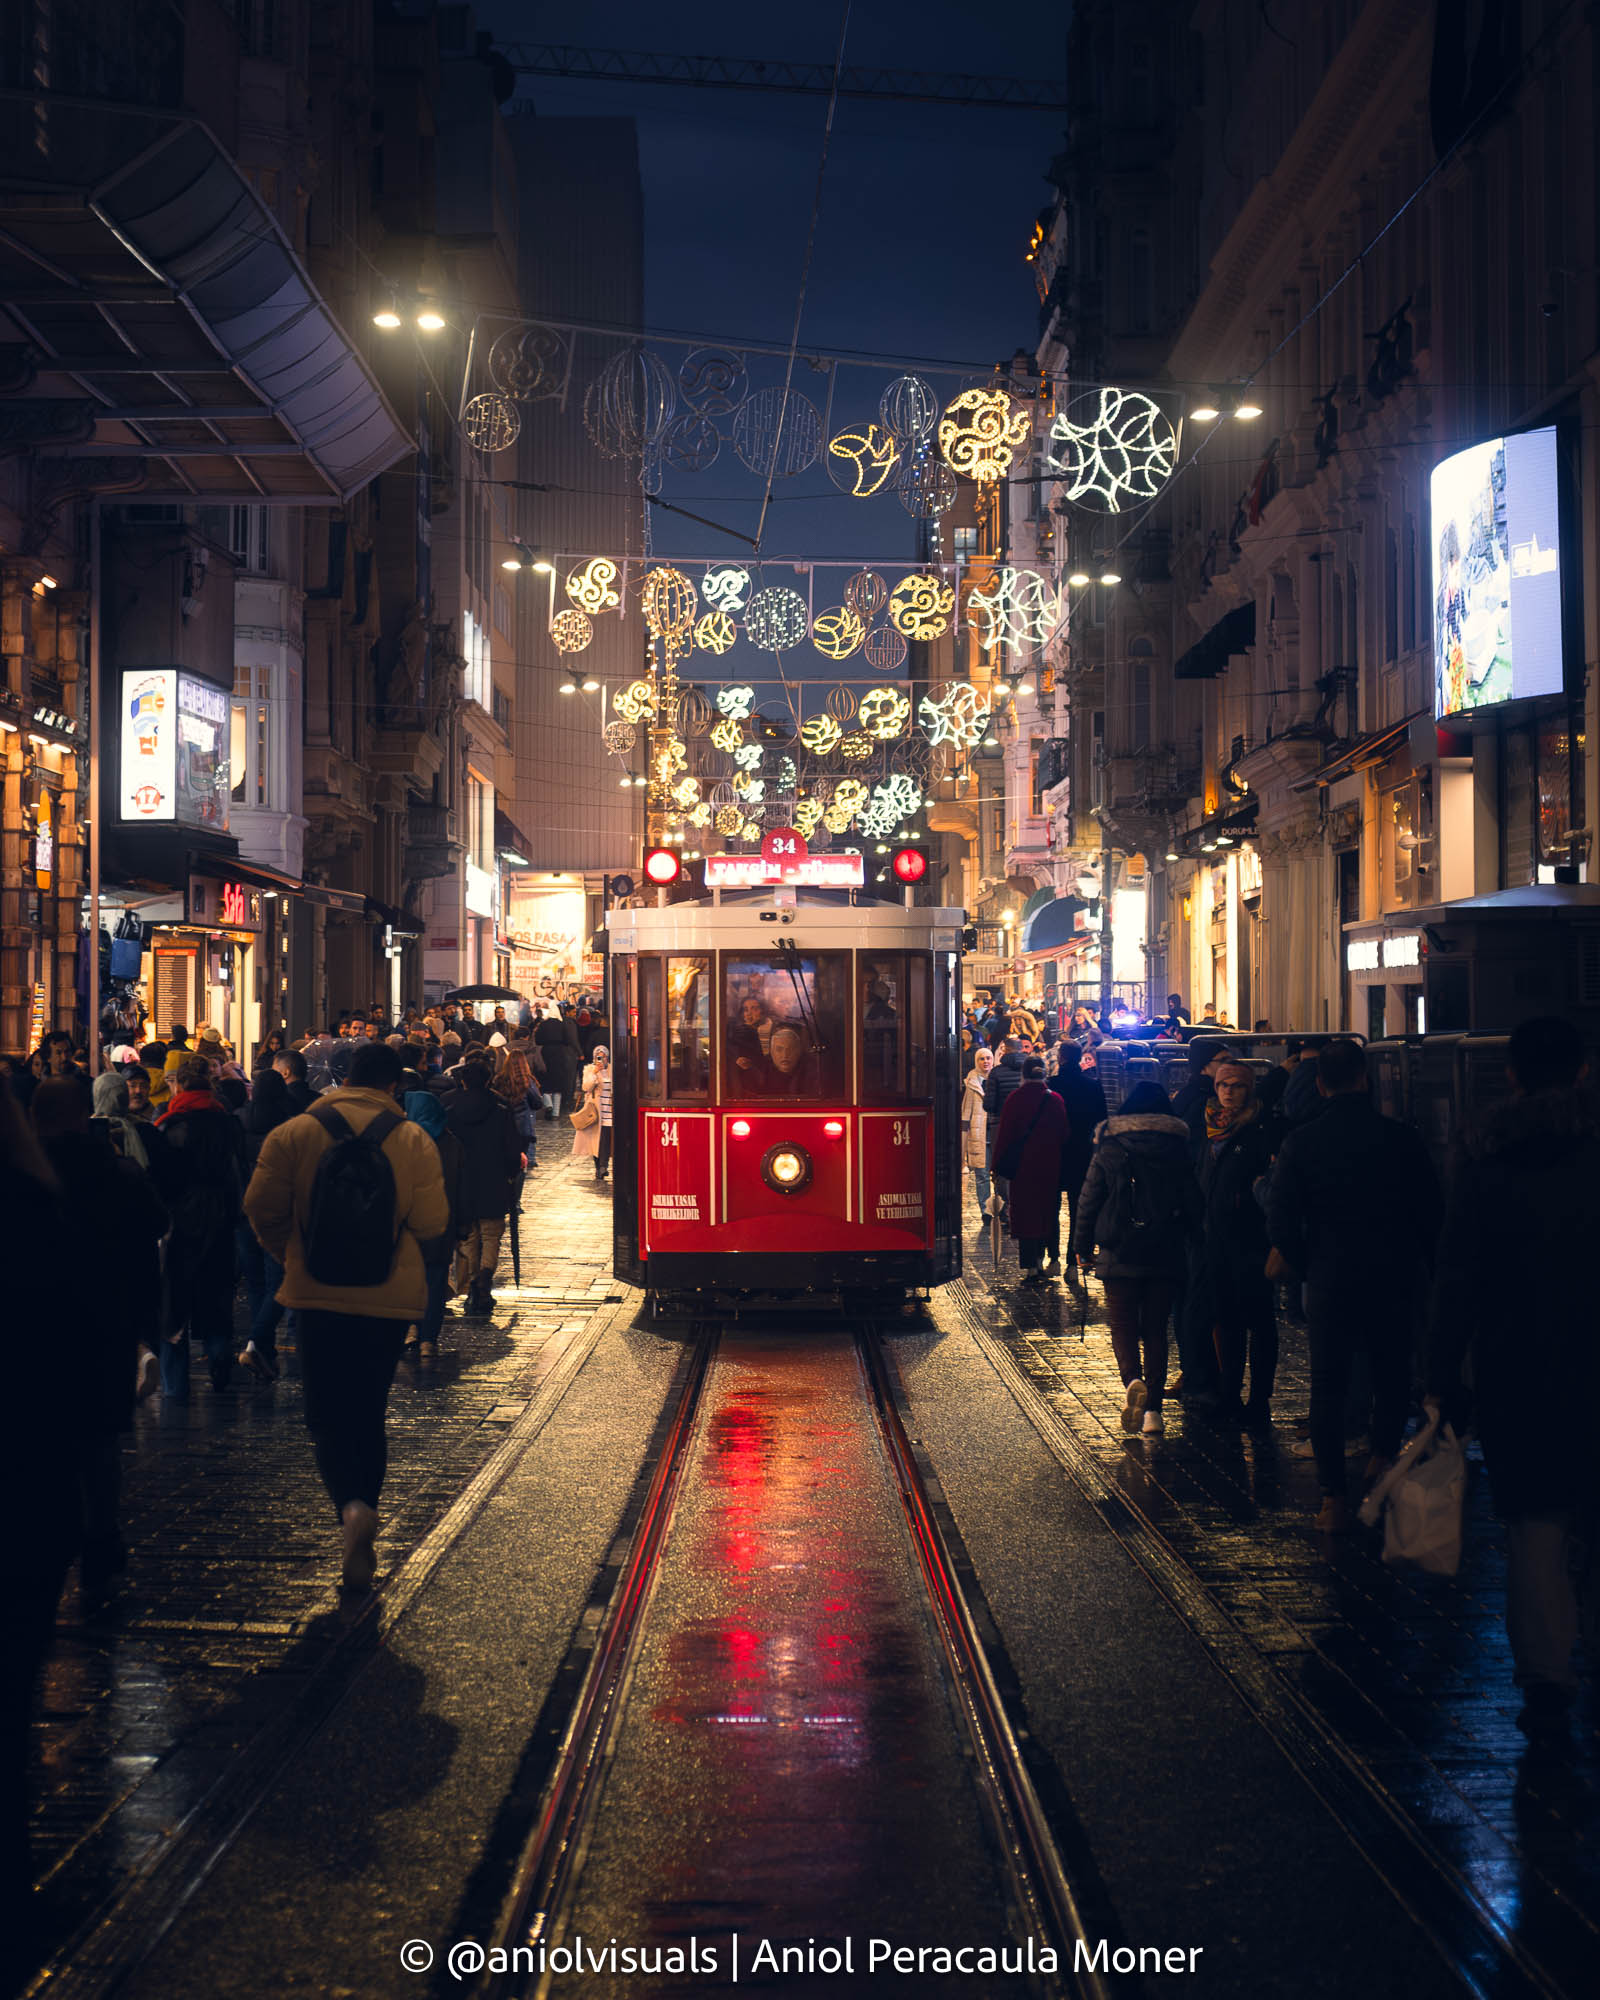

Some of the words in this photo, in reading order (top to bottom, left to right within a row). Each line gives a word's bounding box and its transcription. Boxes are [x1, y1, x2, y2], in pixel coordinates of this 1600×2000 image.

[772, 837, 796, 854] 34
[661, 1121, 679, 1147] 34
[893, 1120, 910, 1145] 34
[674, 1194, 697, 1207] YASAK
[876, 1207, 886, 1220] VE
